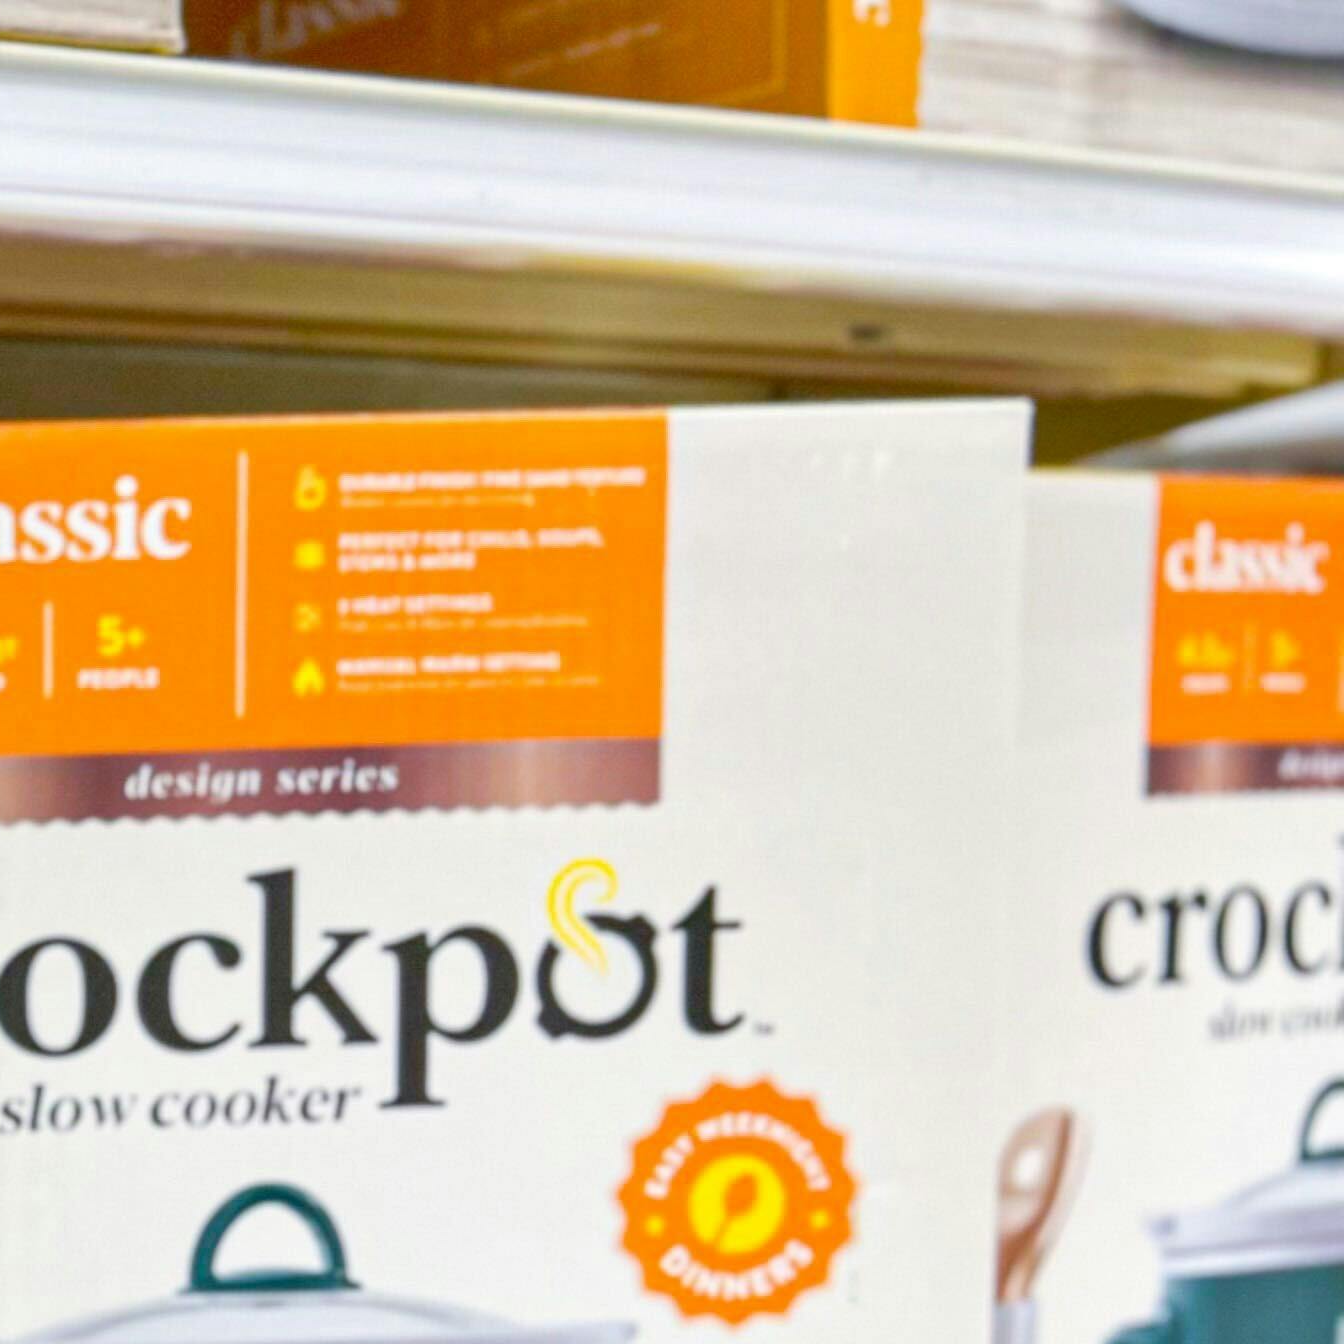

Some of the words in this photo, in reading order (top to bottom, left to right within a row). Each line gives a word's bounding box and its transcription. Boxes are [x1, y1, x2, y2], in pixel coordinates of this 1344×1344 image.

[1163, 520, 1329, 595] classic
[124, 764, 261, 802] design
[276, 760, 400, 794] series
[150, 1075, 362, 1128] cooker
[659, 1239, 814, 1301] DINNERS
